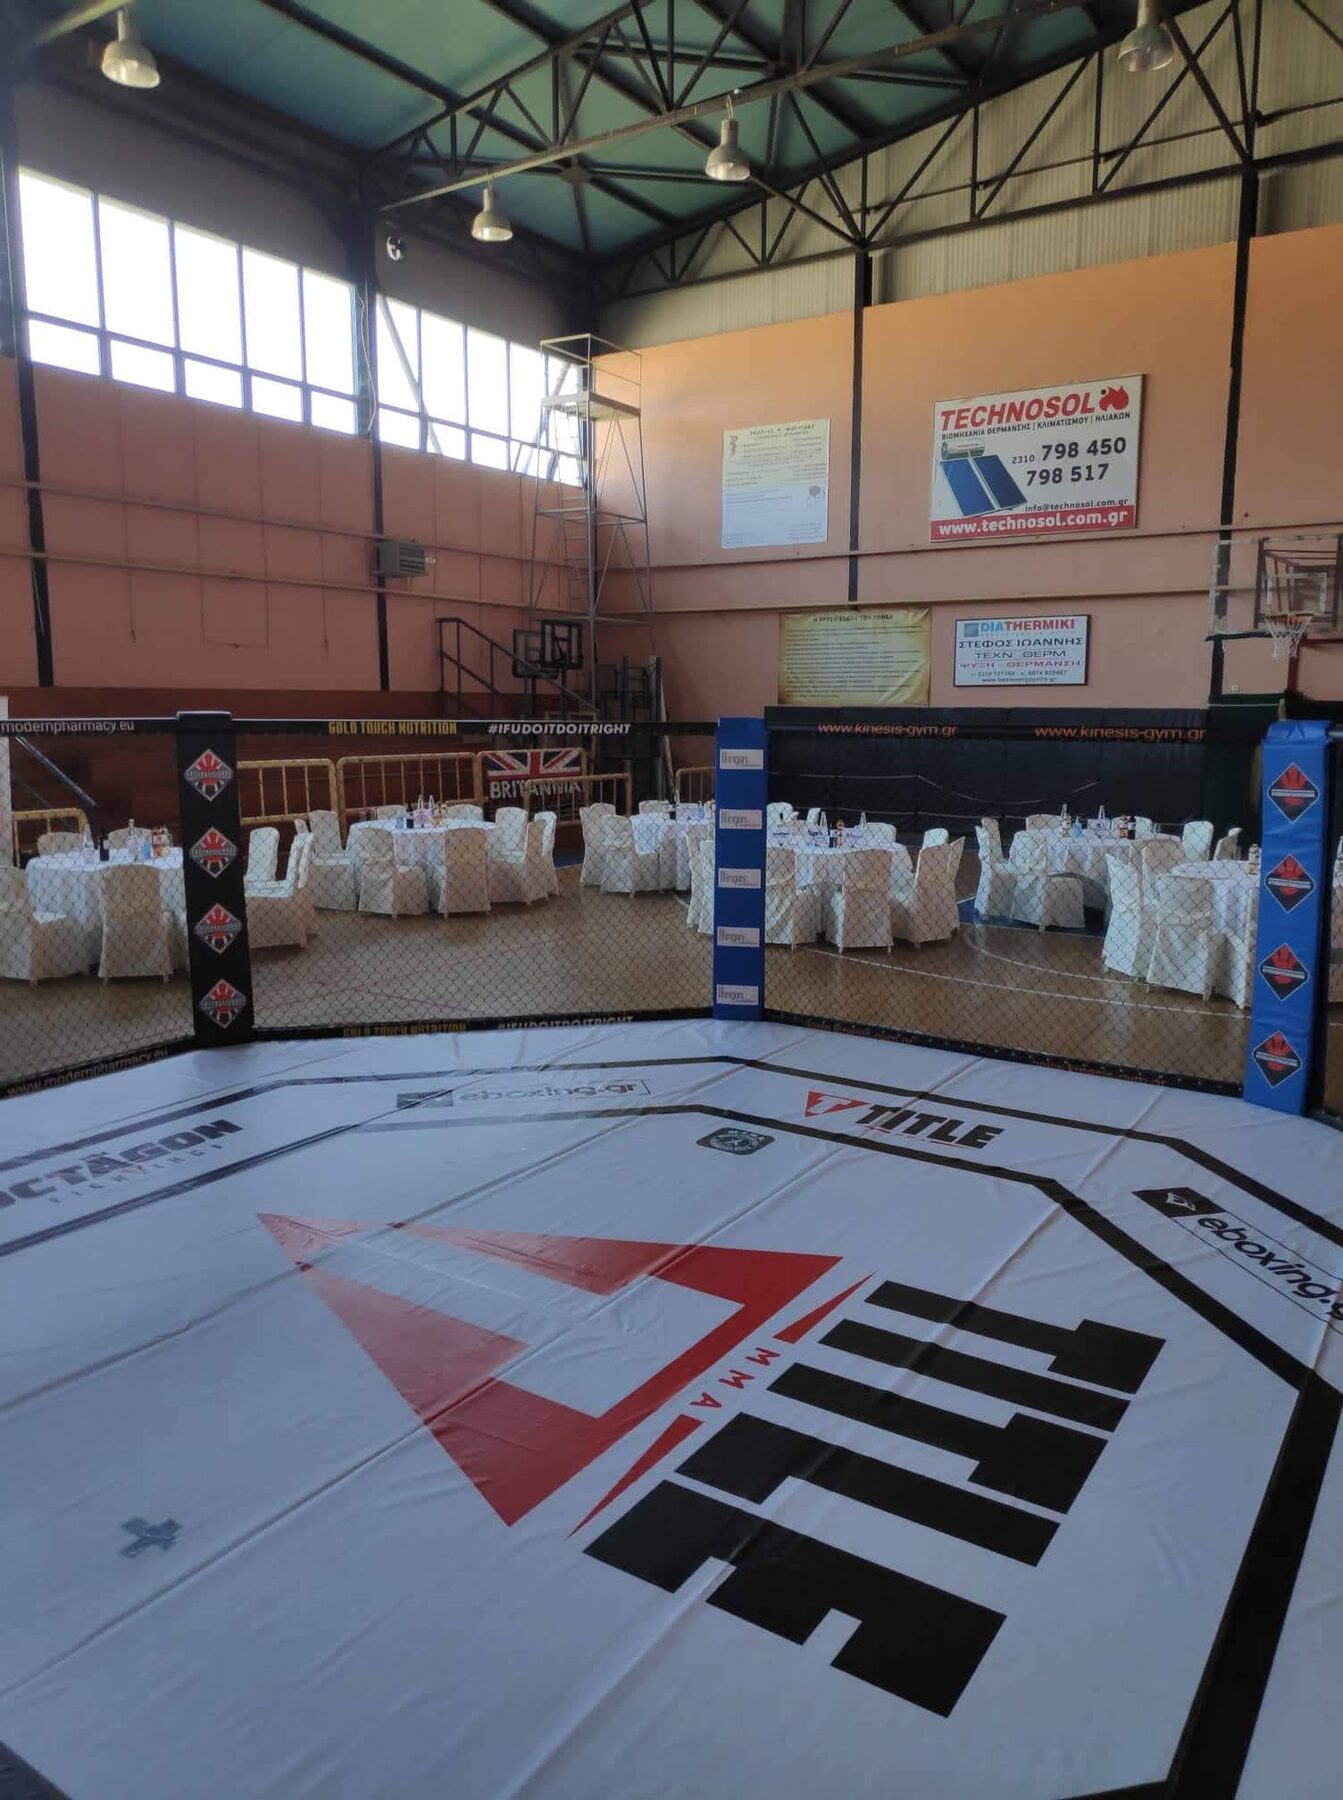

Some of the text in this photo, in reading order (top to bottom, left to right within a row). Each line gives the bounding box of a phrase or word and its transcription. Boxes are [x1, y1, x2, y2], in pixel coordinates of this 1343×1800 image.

[940, 392, 1095, 431] TECHNOSOL
[941, 411, 1131, 440] ΒΙΟΜΗΧΑΝΙΑ ΘΕΡΜΑΝΣΗΣ ΚΛΙΜΑΤΙΣΜΟΥ ΗΛΙΑΚΩΝ
[1011, 437, 1126, 465] 2310 798 450
[1026, 463, 1109, 487] 798 517
[1024, 499, 1128, 513] info@technosol.com.gr
[939, 510, 1128, 536] www.technosol.com.gr
[981, 619, 1075, 632] DIATHERMIKI
[959, 637, 1084, 649] ΣΤΕΦΟΣ ΙΩΑΝΝΗΣ
[975, 650, 1066, 660] ΤΕΧΝ ΘΕΡΜ
[1006, 660, 1080, 669] ΘΕΡΜΑΝΣΗ
[328, 721, 457, 735] GOLD TOUCH NUTRITION
[487, 723, 631, 735] #IFUDOITDOITRIGHT
[817, 722, 958, 737] www.kinesis-gym.gr
[1034, 726, 1207, 741] www.kinesis-gym.gr
[856, 1104, 1005, 1149] TITLE
[689, 1347, 781, 1408] MMA
